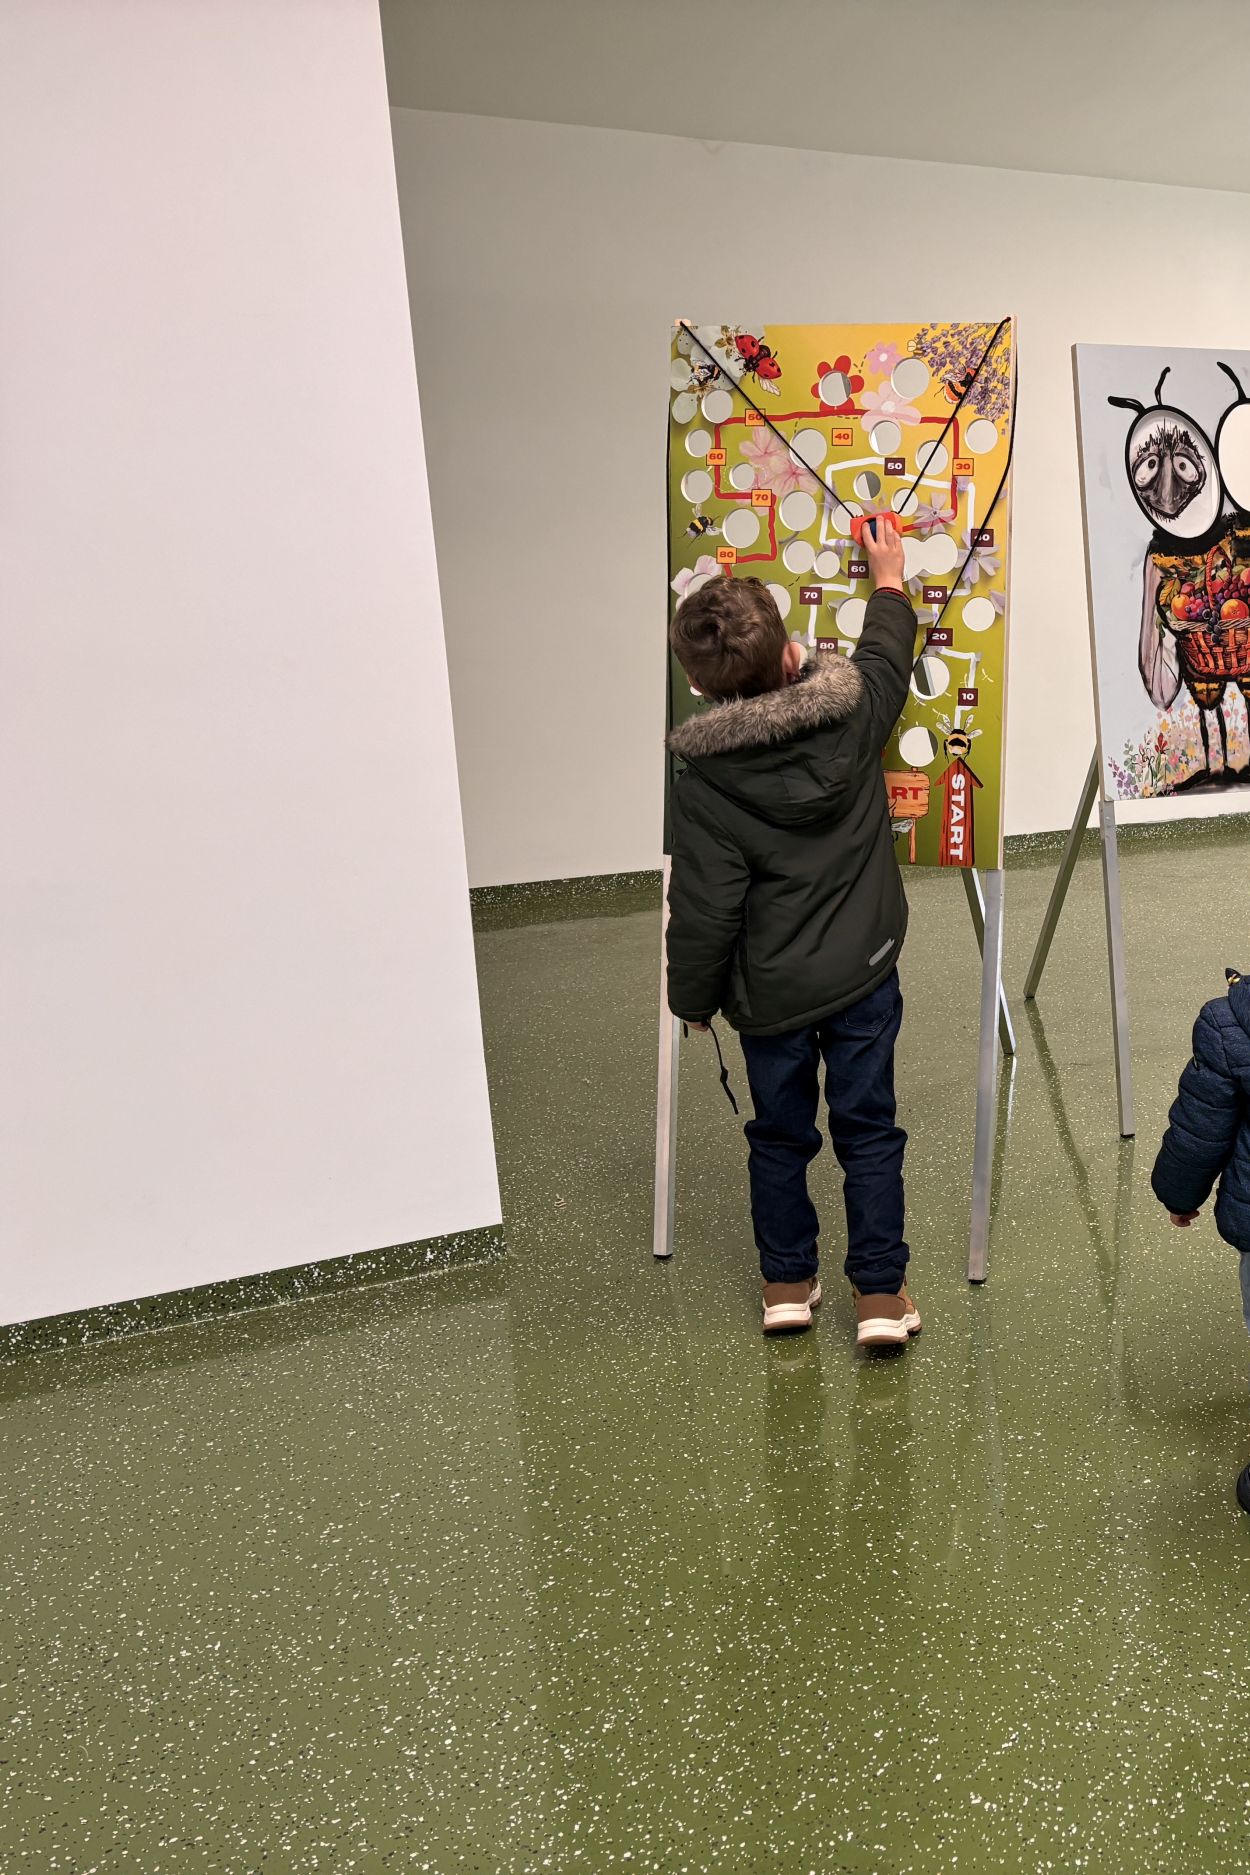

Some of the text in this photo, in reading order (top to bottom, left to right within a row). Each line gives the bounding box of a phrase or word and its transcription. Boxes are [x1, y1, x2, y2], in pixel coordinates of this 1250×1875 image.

[748, 413, 763, 421] 50
[834, 433, 850, 441] 40
[887, 462, 902, 470] 50
[850, 565, 866, 573] 60
[803, 591, 819, 599] 70
[927, 591, 943, 599] 30
[931, 632, 948, 640] 20
[819, 642, 835, 650] 80
[961, 692, 974, 701] 10
[950, 773, 964, 861] START
